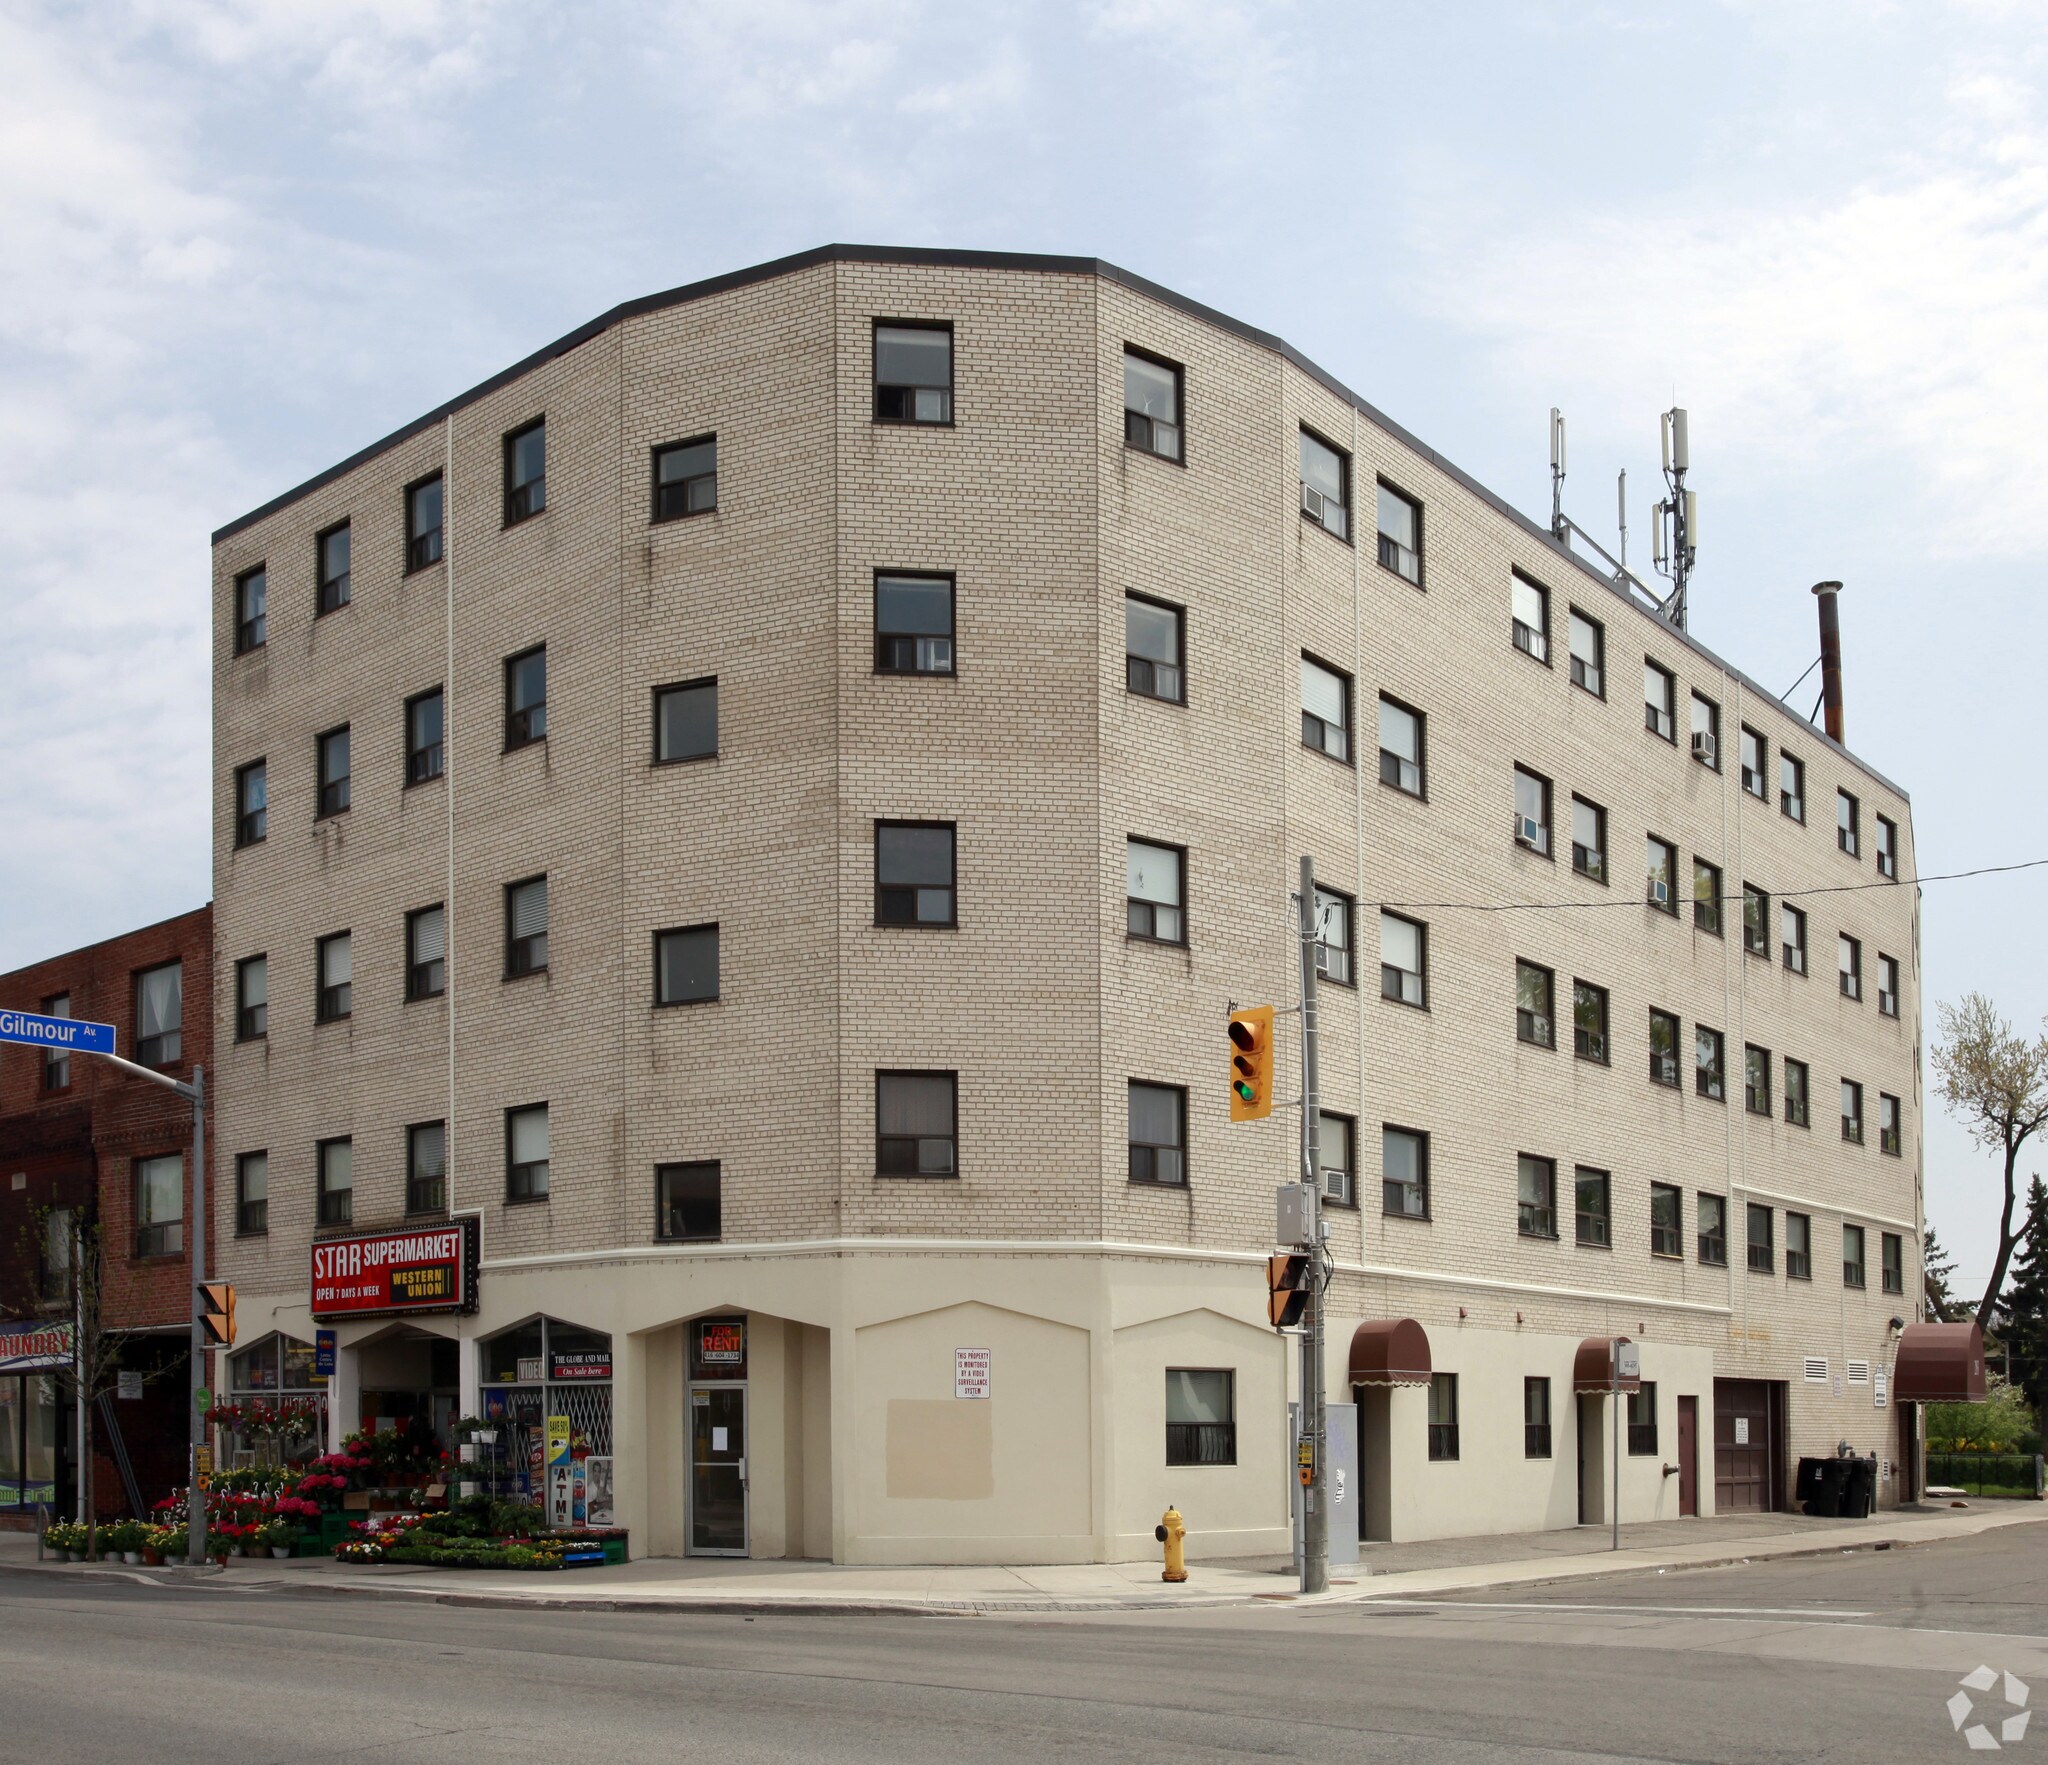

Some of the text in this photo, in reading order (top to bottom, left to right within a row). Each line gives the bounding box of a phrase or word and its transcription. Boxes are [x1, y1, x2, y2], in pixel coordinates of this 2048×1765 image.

[0, 1013, 76, 1042] Gilmour
[315, 1234, 458, 1279] STAR SUPERMARKET
[392, 1268, 442, 1285] WESTERN
[316, 1285, 380, 1301] OPEN 7 DAYS A WEEK
[408, 1283, 442, 1297] UNION
[712, 1327, 732, 1336] FOR
[704, 1337, 739, 1350] RENT
[566, 1355, 583, 1363] GLOBE
[597, 1354, 610, 1362] MAIL
[573, 1367, 587, 1376] Sale
[588, 1367, 602, 1375] here
[556, 1468, 566, 1514] ATM
